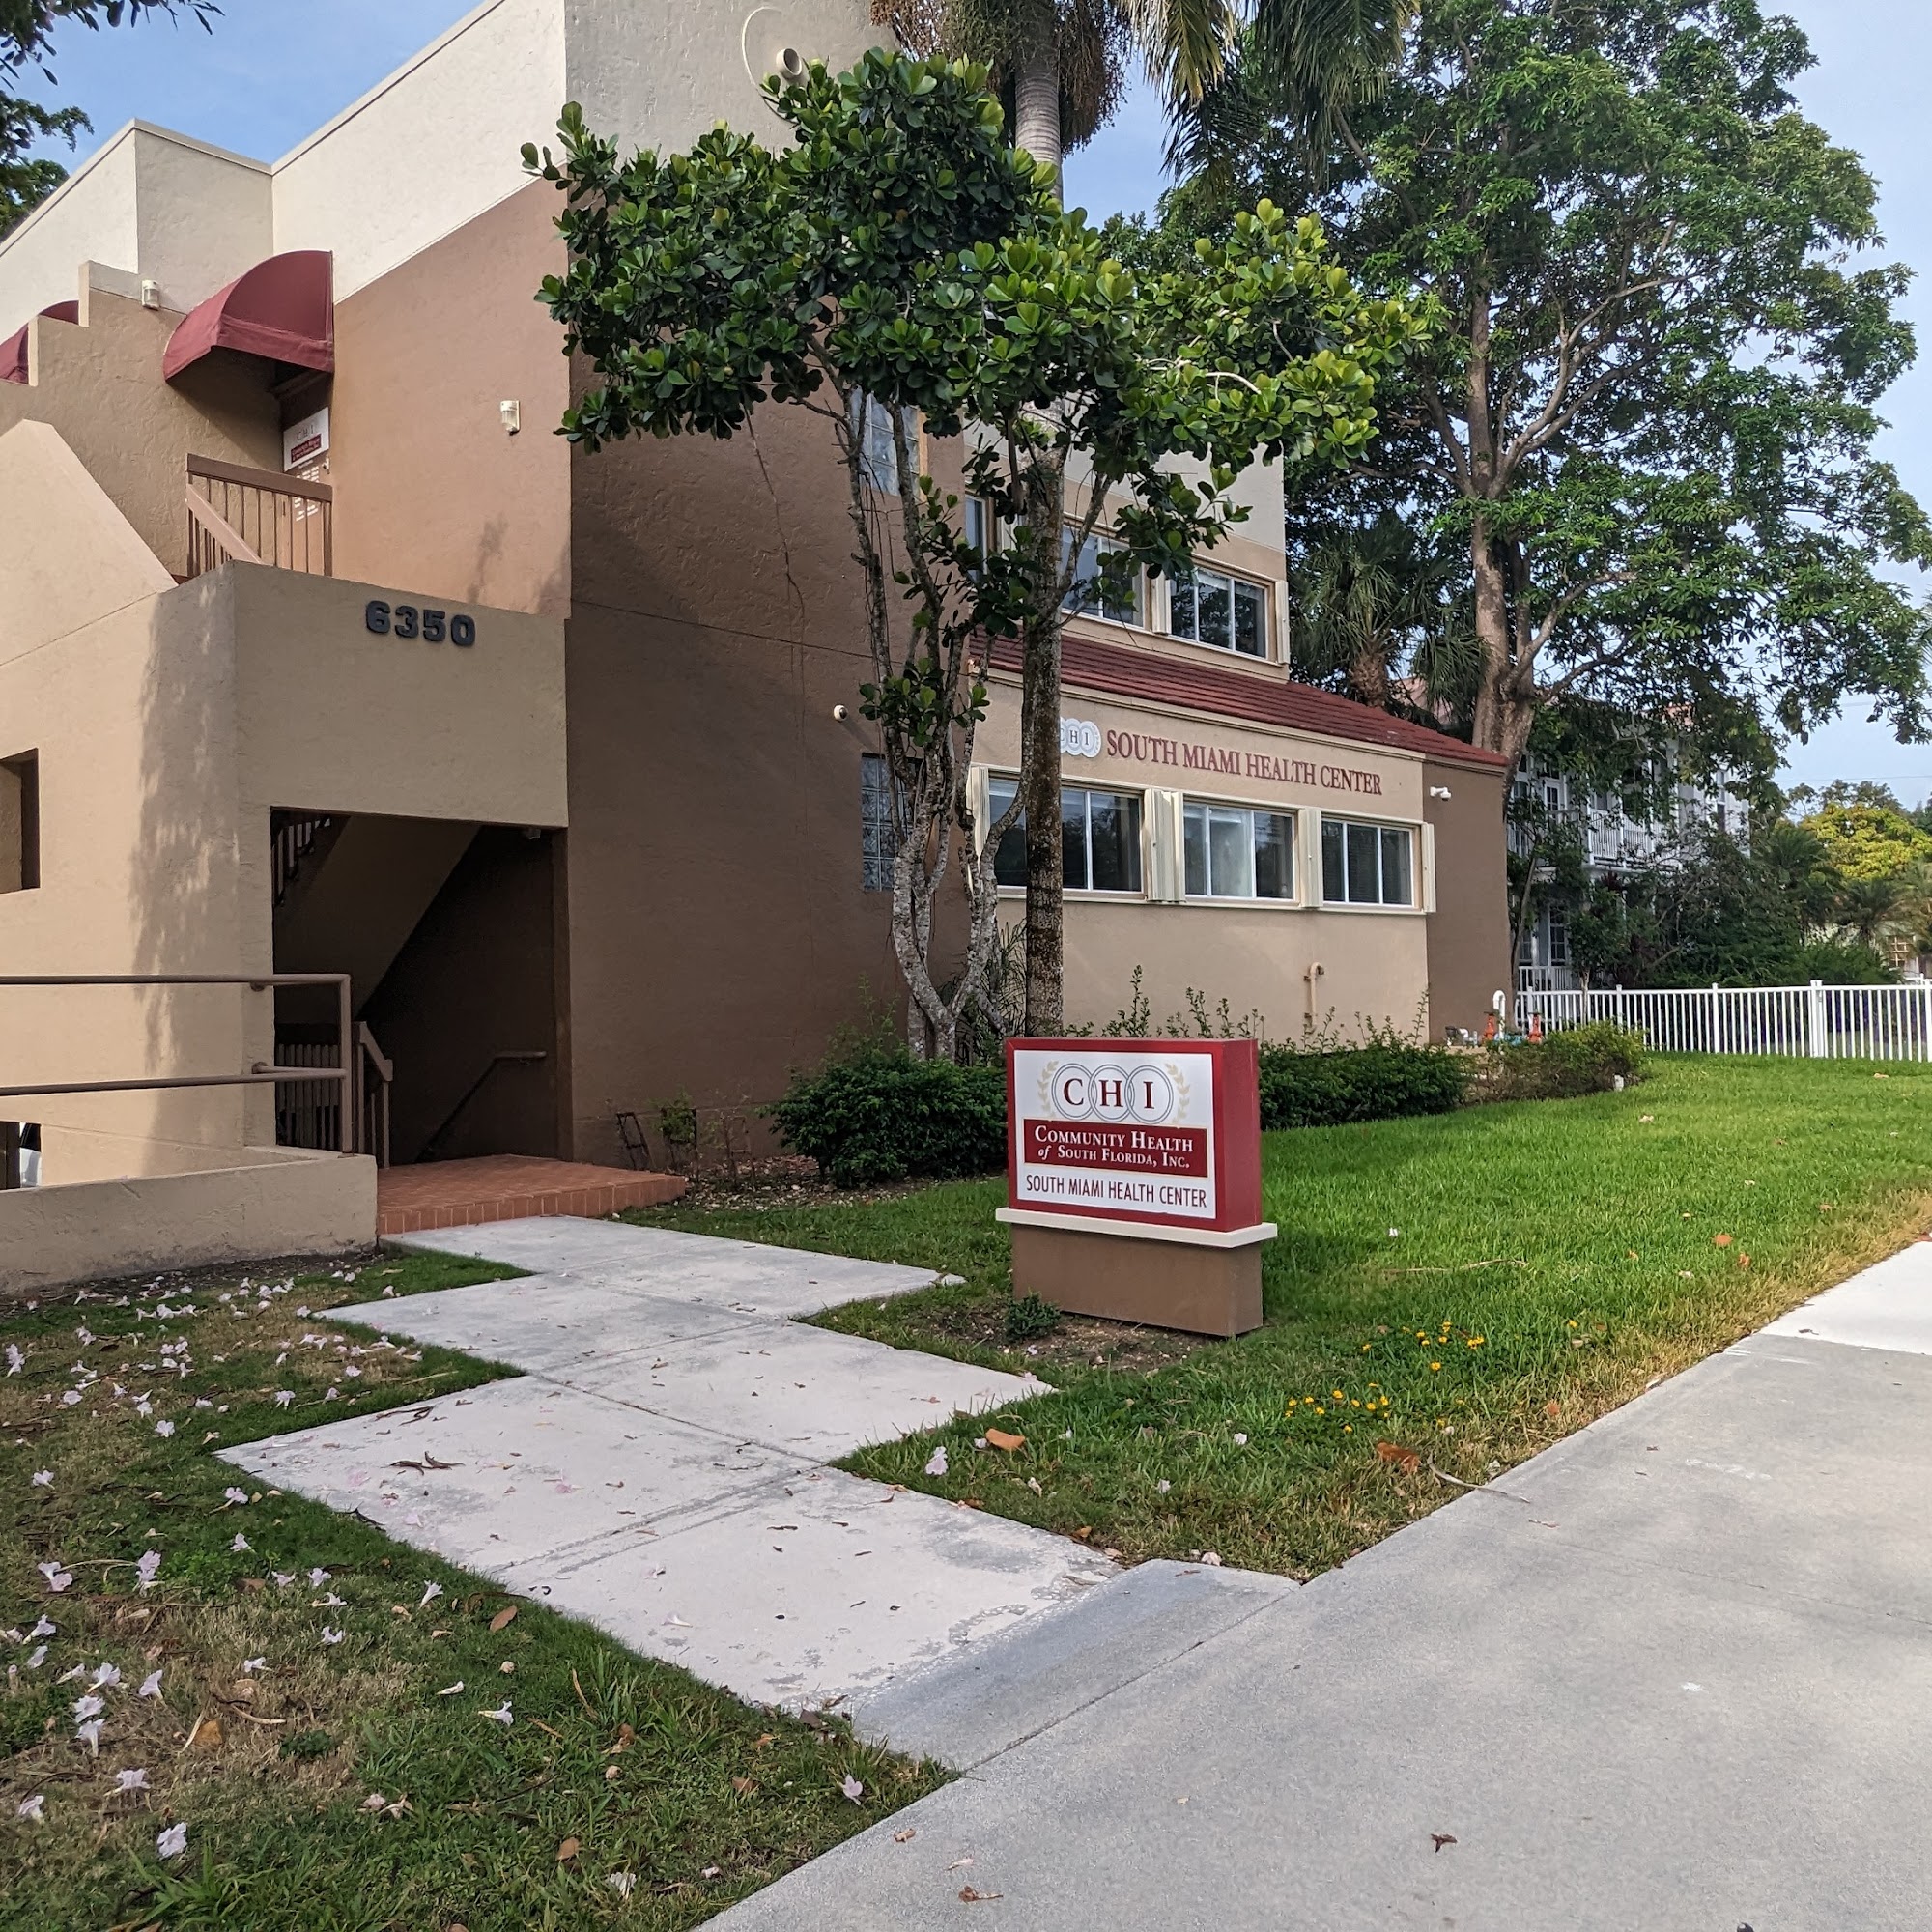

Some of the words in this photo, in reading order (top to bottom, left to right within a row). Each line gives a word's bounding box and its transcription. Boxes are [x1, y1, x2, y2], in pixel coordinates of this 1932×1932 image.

[366, 600, 476, 646] 6350
[1107, 729, 1179, 766] SOUTH
[1182, 743, 1241, 774] MIAMI
[1245, 753, 1317, 786] HEALTH
[1320, 765, 1382, 795] CENTER
[1037, 1145, 1052, 1160] of
[1026, 1175, 1065, 1195] SOUTH
[1068, 1178, 1104, 1199] MIAMI
[1109, 1182, 1155, 1203] HEALTH
[1159, 1186, 1208, 1208] CENTER
